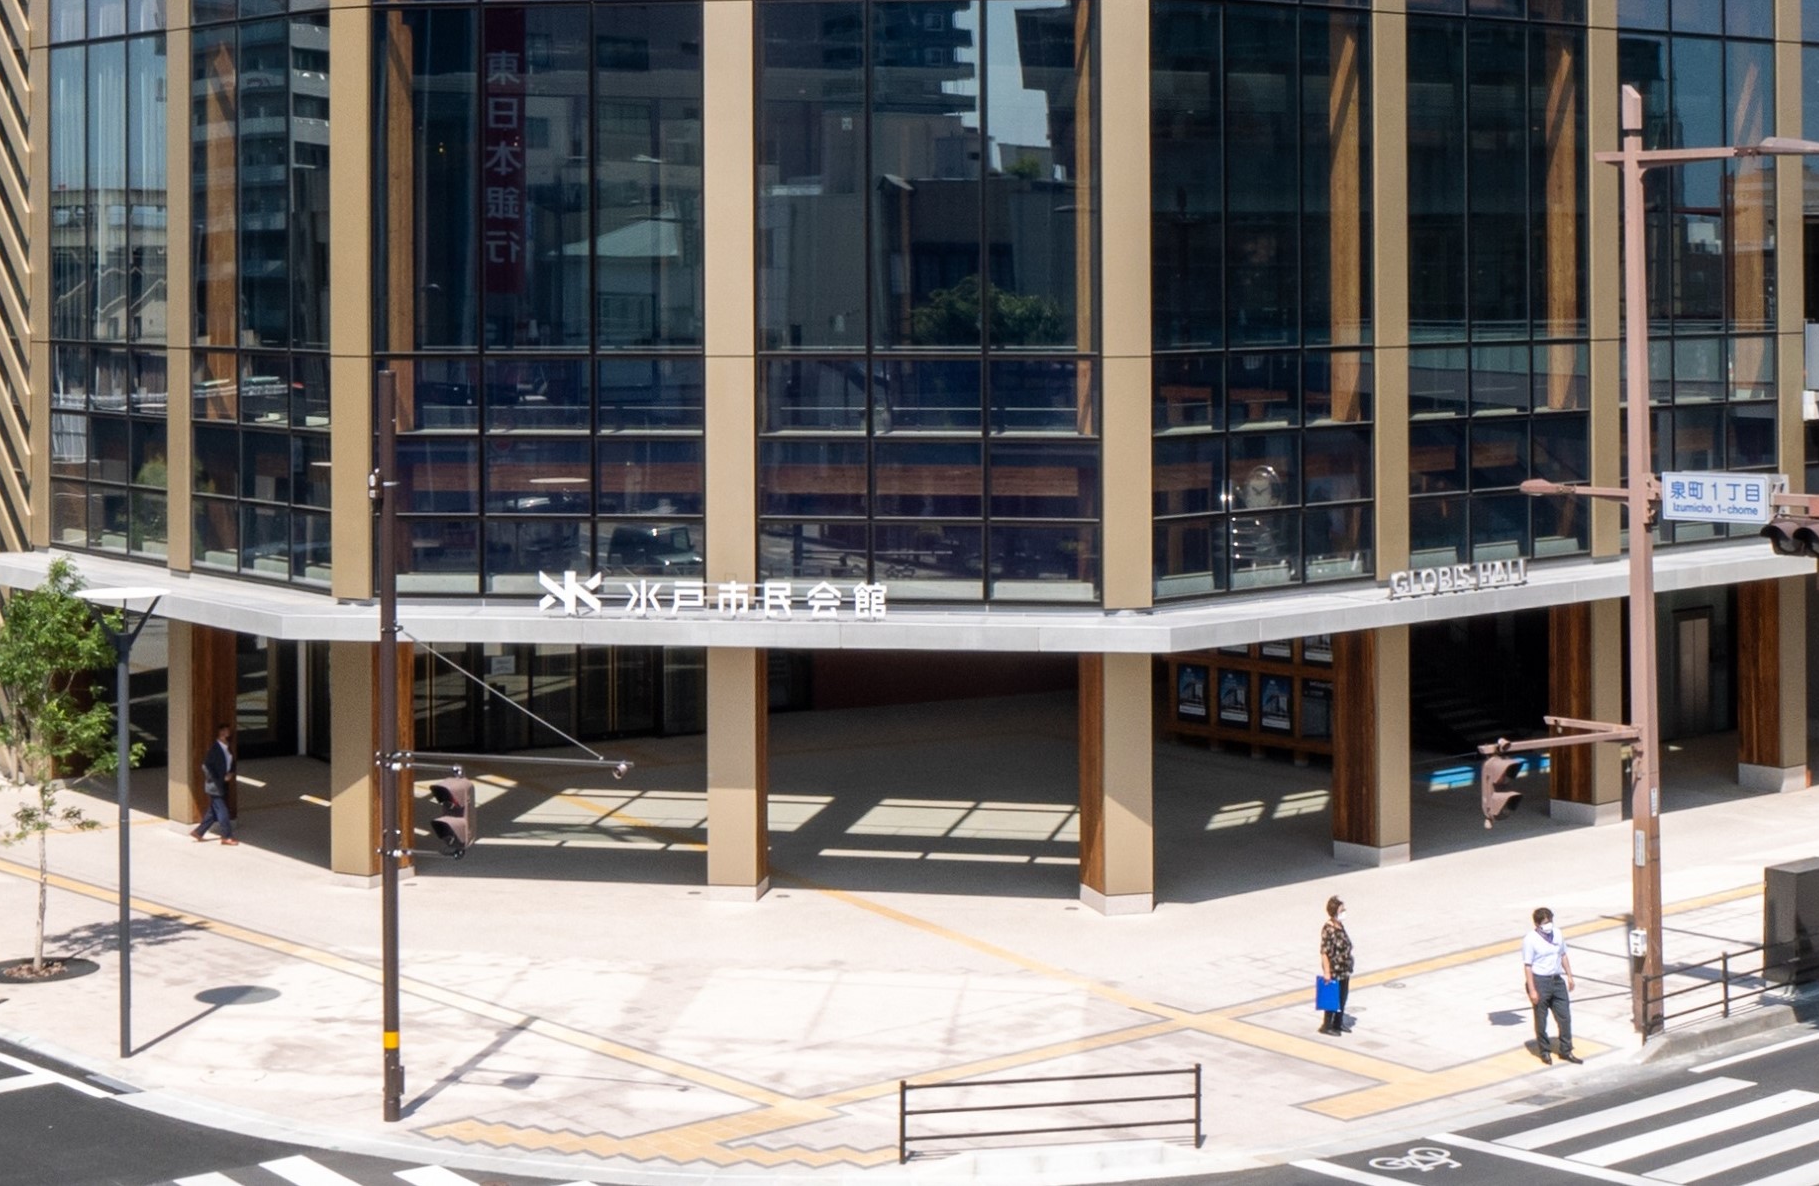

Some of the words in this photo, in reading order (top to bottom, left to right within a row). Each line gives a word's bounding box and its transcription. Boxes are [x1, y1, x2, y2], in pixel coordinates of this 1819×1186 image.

[1670, 480, 1760, 502] 泉町1丁目
[1672, 502, 1713, 513] Izumicho
[1717, 504, 1759, 516] 1-chome
[1390, 565, 1472, 596] GLOBIS
[1479, 558, 1527, 586] HALL
[625, 578, 887, 617] 水戸市民会館
